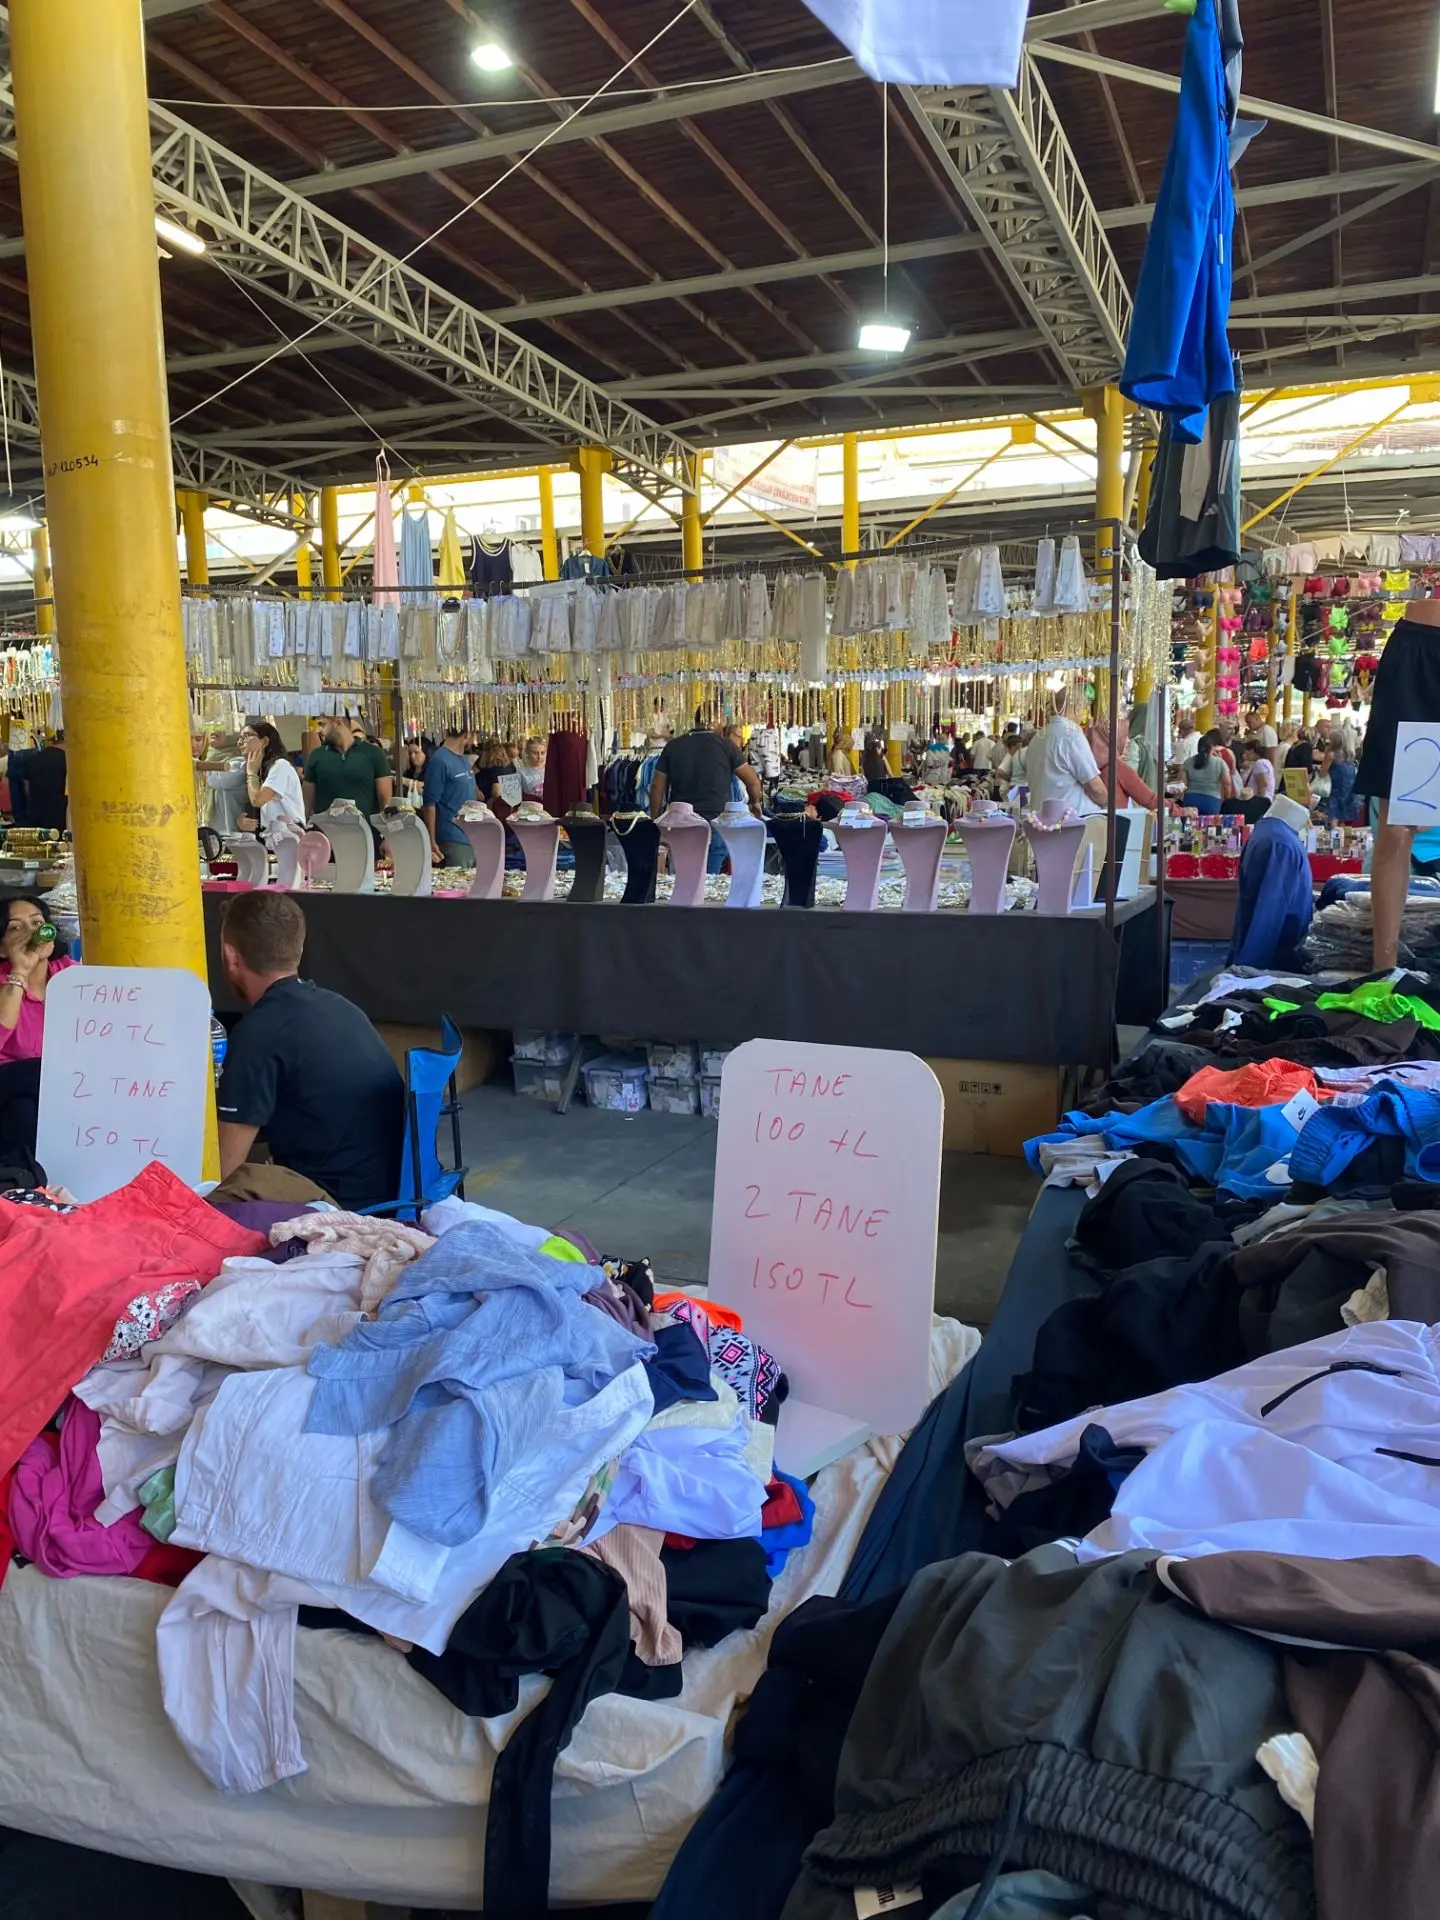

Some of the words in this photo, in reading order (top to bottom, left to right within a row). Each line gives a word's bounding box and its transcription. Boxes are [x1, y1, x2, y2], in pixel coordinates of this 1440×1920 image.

[1397, 737, 1440, 809] 2
[73, 984, 142, 1003] TANE
[75, 1017, 113, 1043] 100
[126, 1024, 166, 1046] TL
[72, 1071, 92, 1098] 2
[111, 1077, 176, 1098] TANE
[765, 1068, 852, 1097] TANE
[75, 1125, 118, 1147] 150
[133, 1137, 169, 1158] TL
[755, 1112, 805, 1143] 100
[744, 1184, 770, 1219] 2
[787, 1190, 890, 1238] TANE
[753, 1257, 803, 1291] 150
[818, 1272, 873, 1308] TL
